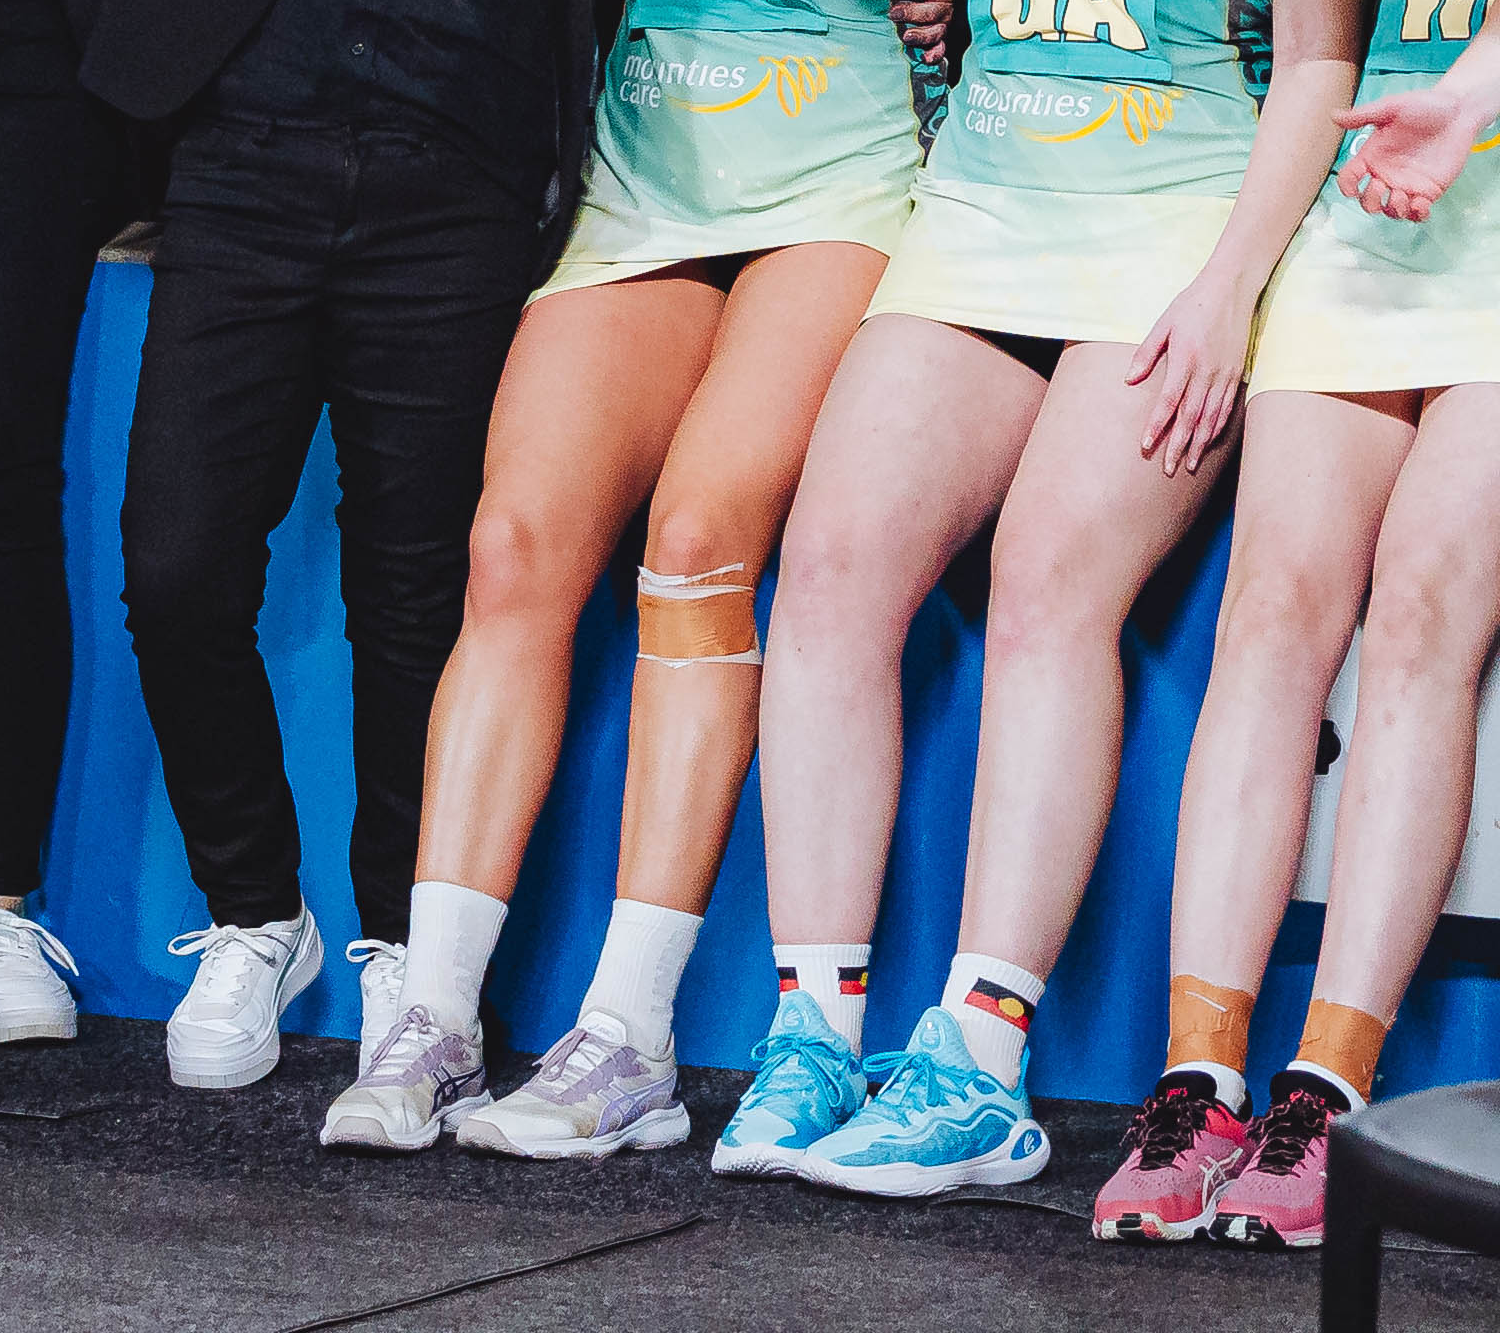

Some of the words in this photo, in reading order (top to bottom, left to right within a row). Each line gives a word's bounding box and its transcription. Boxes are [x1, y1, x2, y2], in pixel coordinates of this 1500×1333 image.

[623, 53, 746, 89] mounties
[619, 79, 661, 108] care
[966, 82, 1092, 118] mounties
[965, 113, 1007, 137] care
